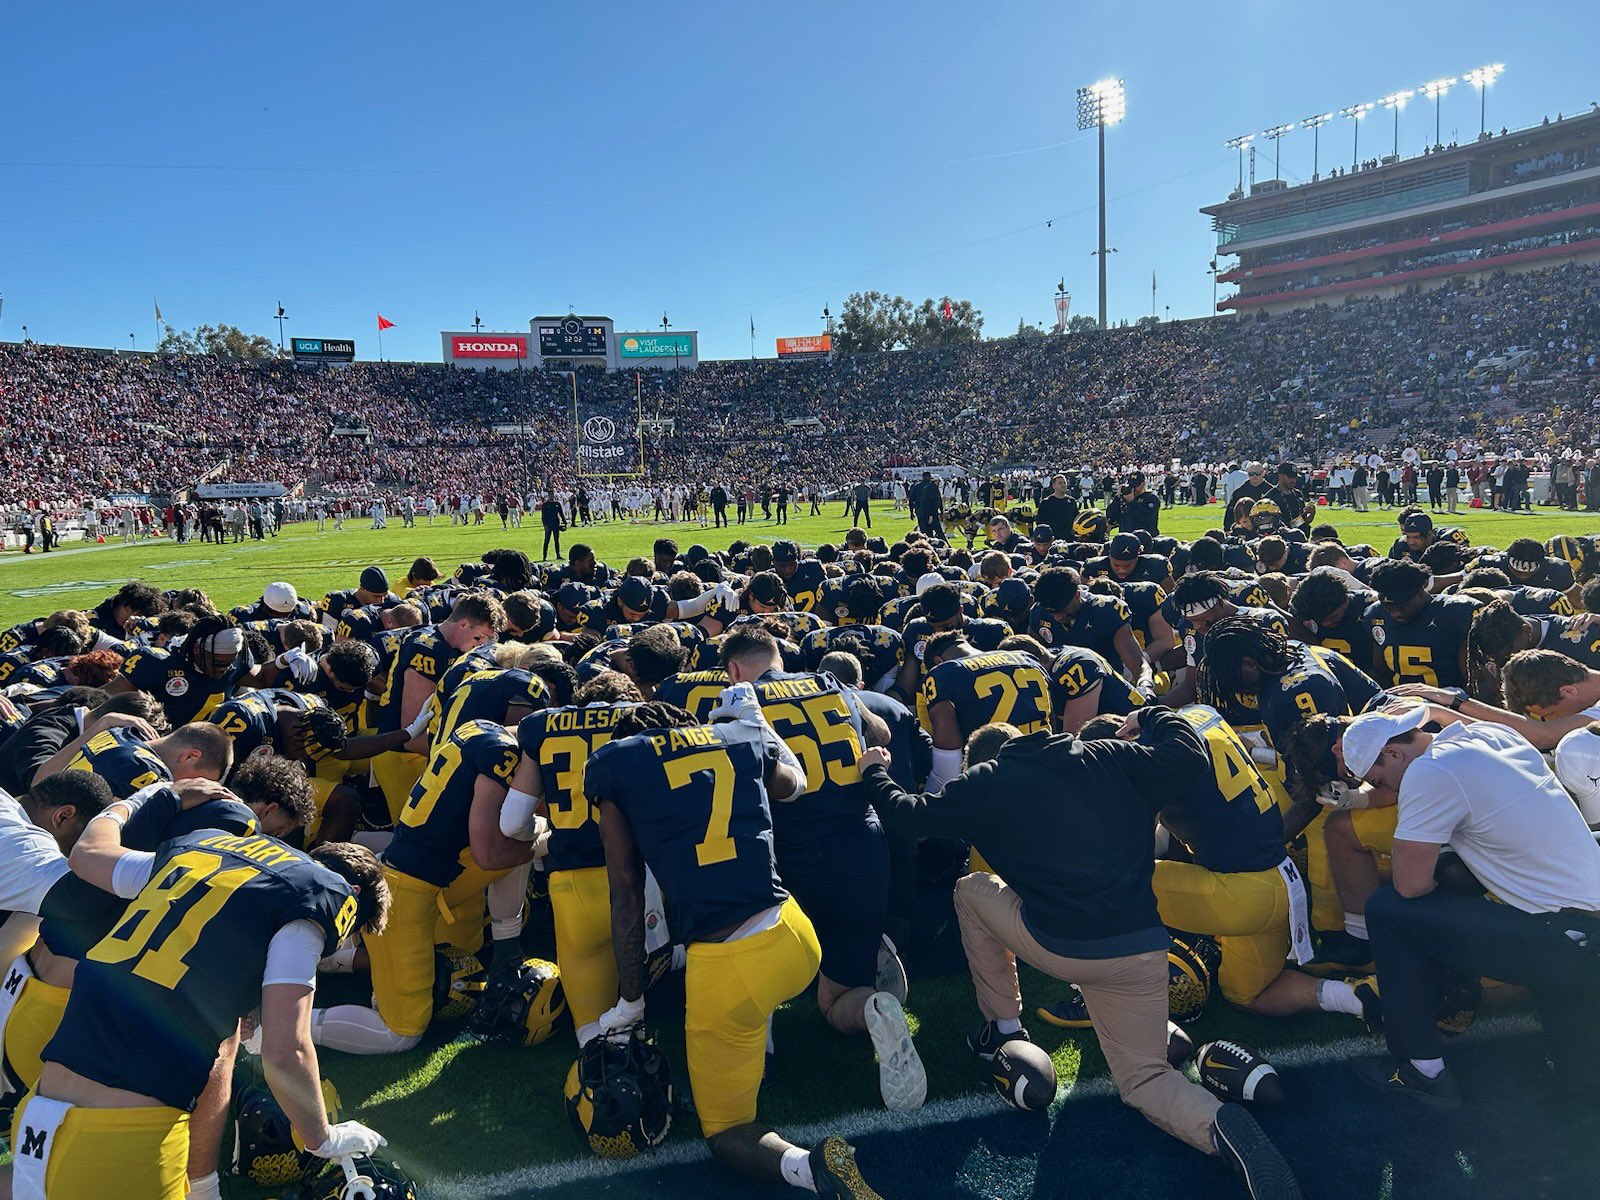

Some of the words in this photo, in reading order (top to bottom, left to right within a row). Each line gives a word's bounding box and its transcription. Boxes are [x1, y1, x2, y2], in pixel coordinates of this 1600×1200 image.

[323, 342, 352, 352] Health
[458, 343, 521, 352] HONDA
[578, 445, 624, 458] Allstate
[410, 652, 436, 675] 40
[758, 678, 821, 701] ZINTER
[1059, 663, 1088, 696] 37
[545, 707, 642, 733] KOLESA
[651, 725, 722, 756] PAIGE
[760, 693, 864, 795] 65
[662, 748, 737, 867] 7
[1283, 862, 1298, 883] M
[86, 851, 262, 990] 81
[4, 968, 24, 995] M
[20, 1125, 48, 1160] M
